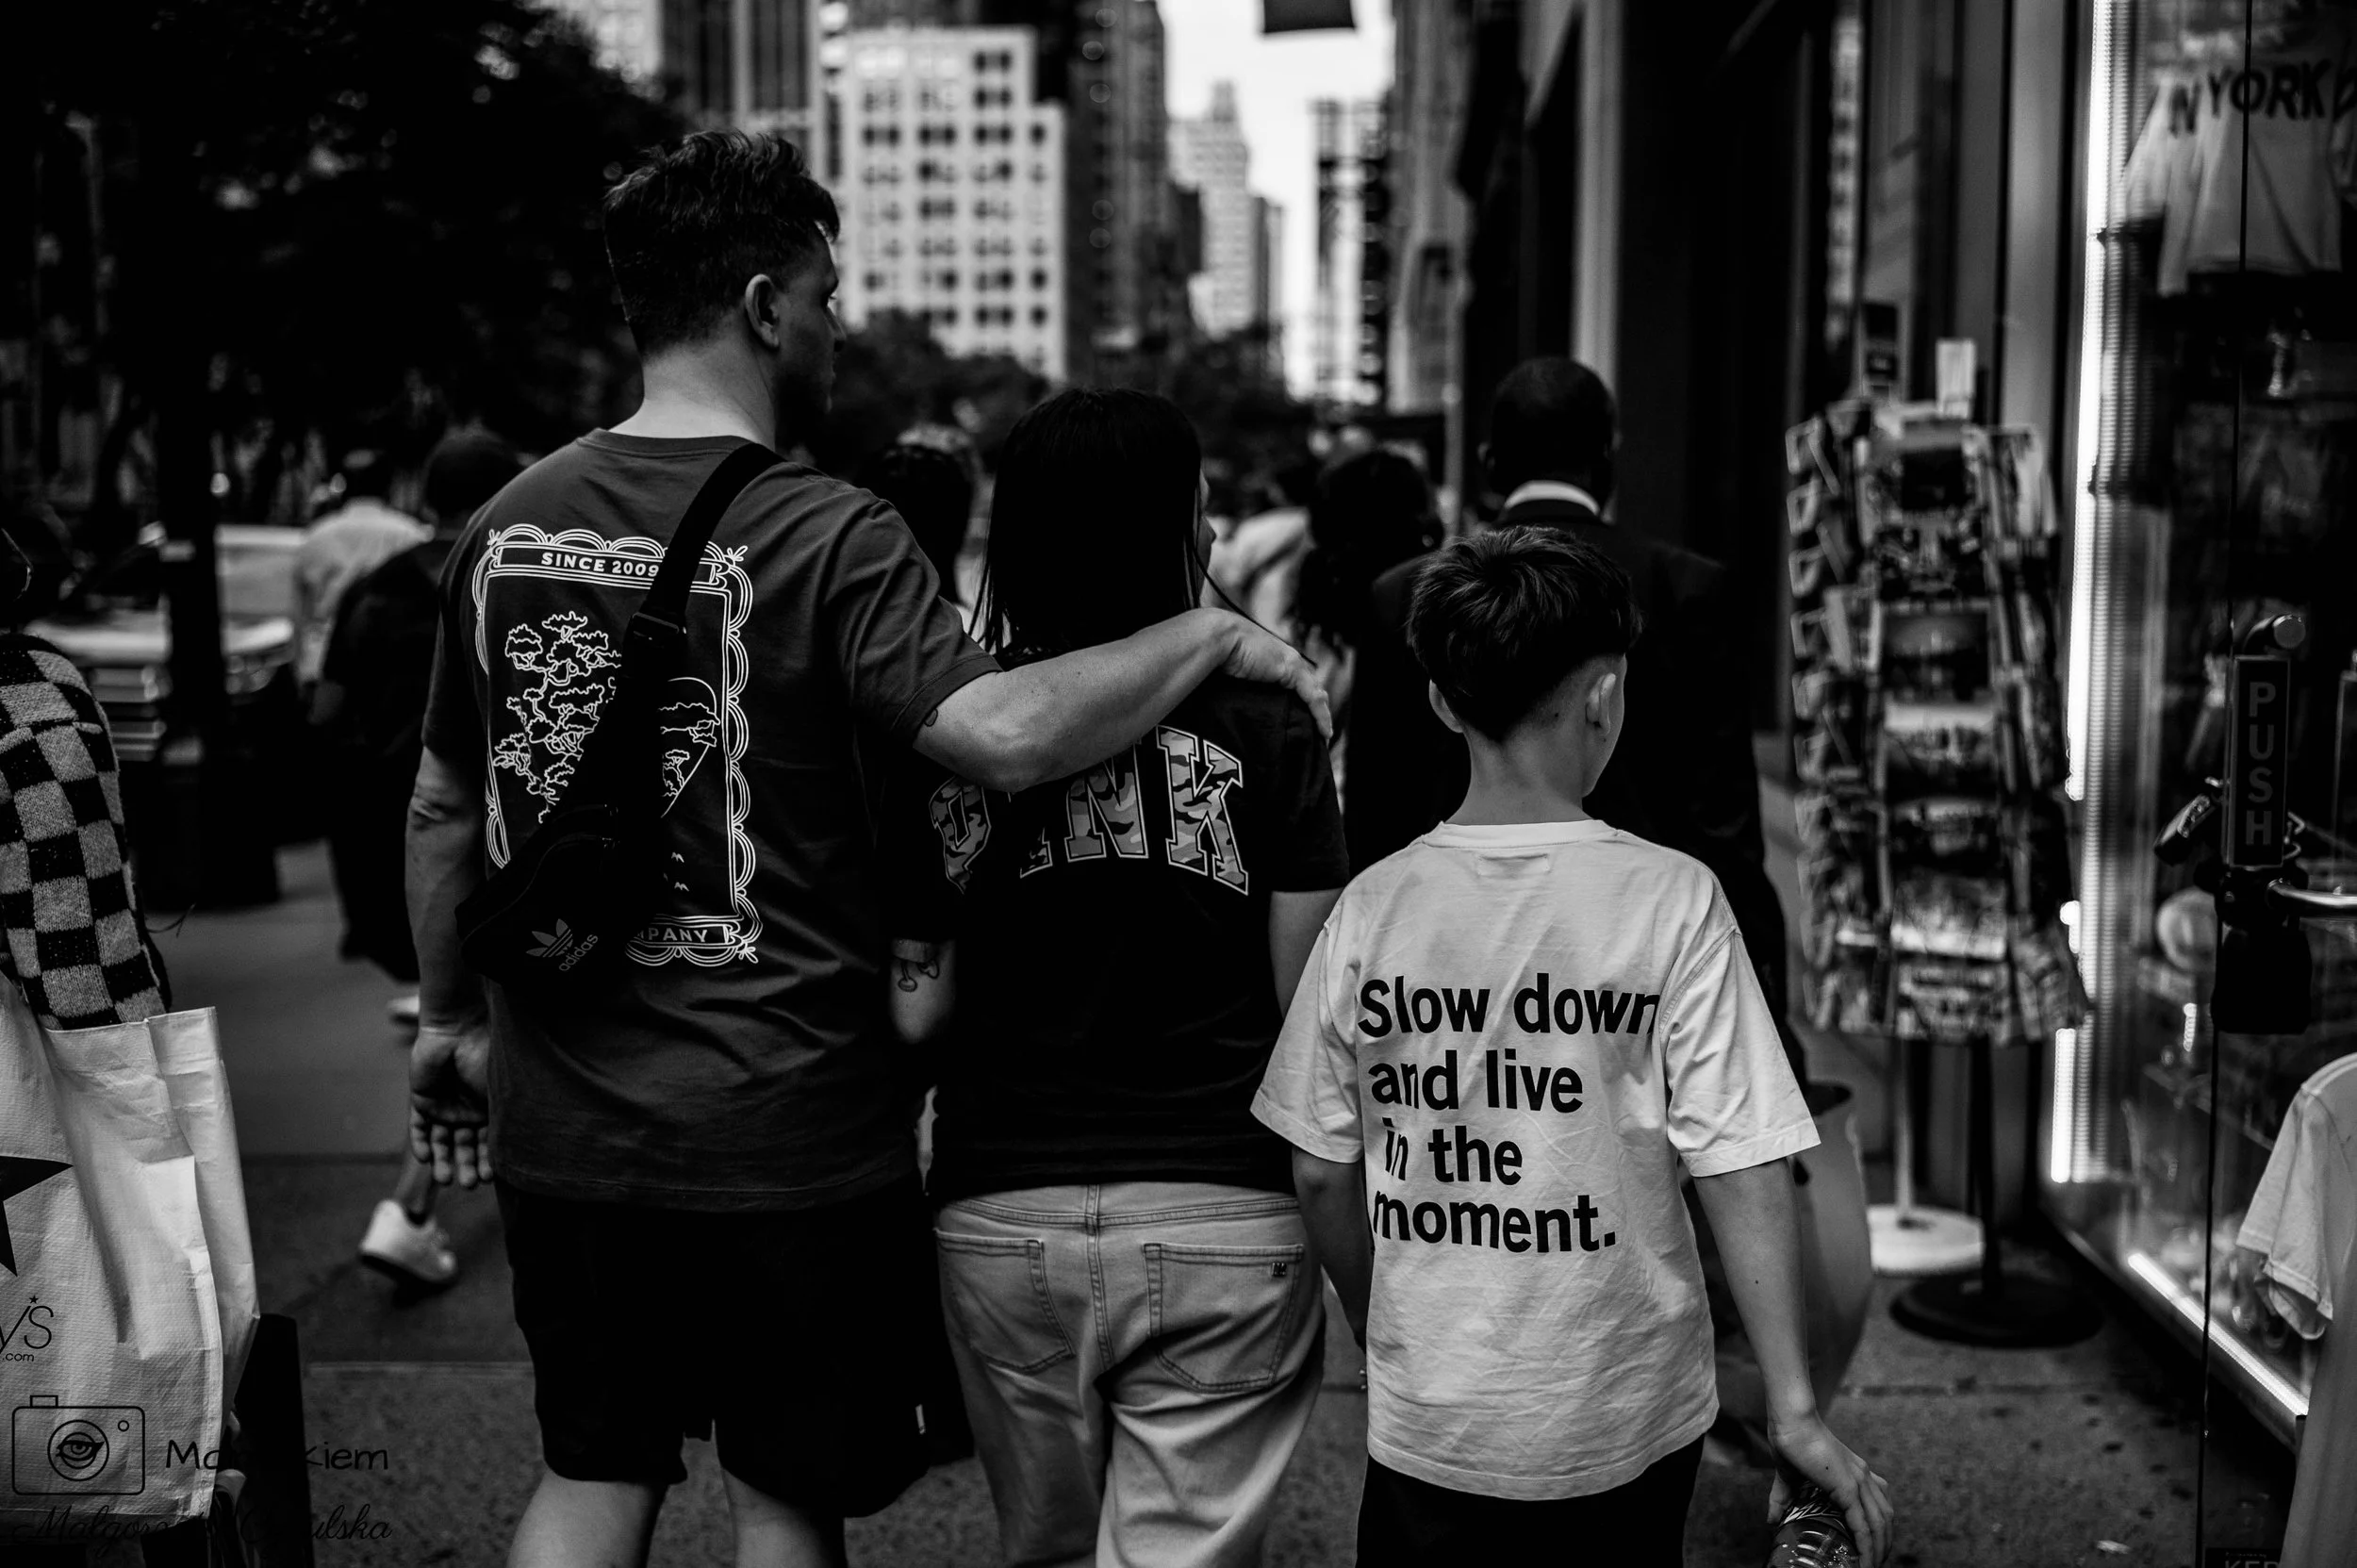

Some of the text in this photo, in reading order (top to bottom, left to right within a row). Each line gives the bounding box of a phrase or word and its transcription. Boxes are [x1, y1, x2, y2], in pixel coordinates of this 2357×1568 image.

[2208, 58, 2332, 122] YORK
[540, 552, 660, 578] SINCE 2009
[2245, 681, 2277, 847] PUSH
[929, 723, 1250, 896] PNK
[558, 933, 599, 973] adidas
[636, 927, 708, 944] PANY
[1358, 972, 1661, 1039] Slow down
[1368, 1048, 1584, 1114] and live
[1382, 1117, 1524, 1186] in the
[1373, 1190, 1617, 1254] moment.
